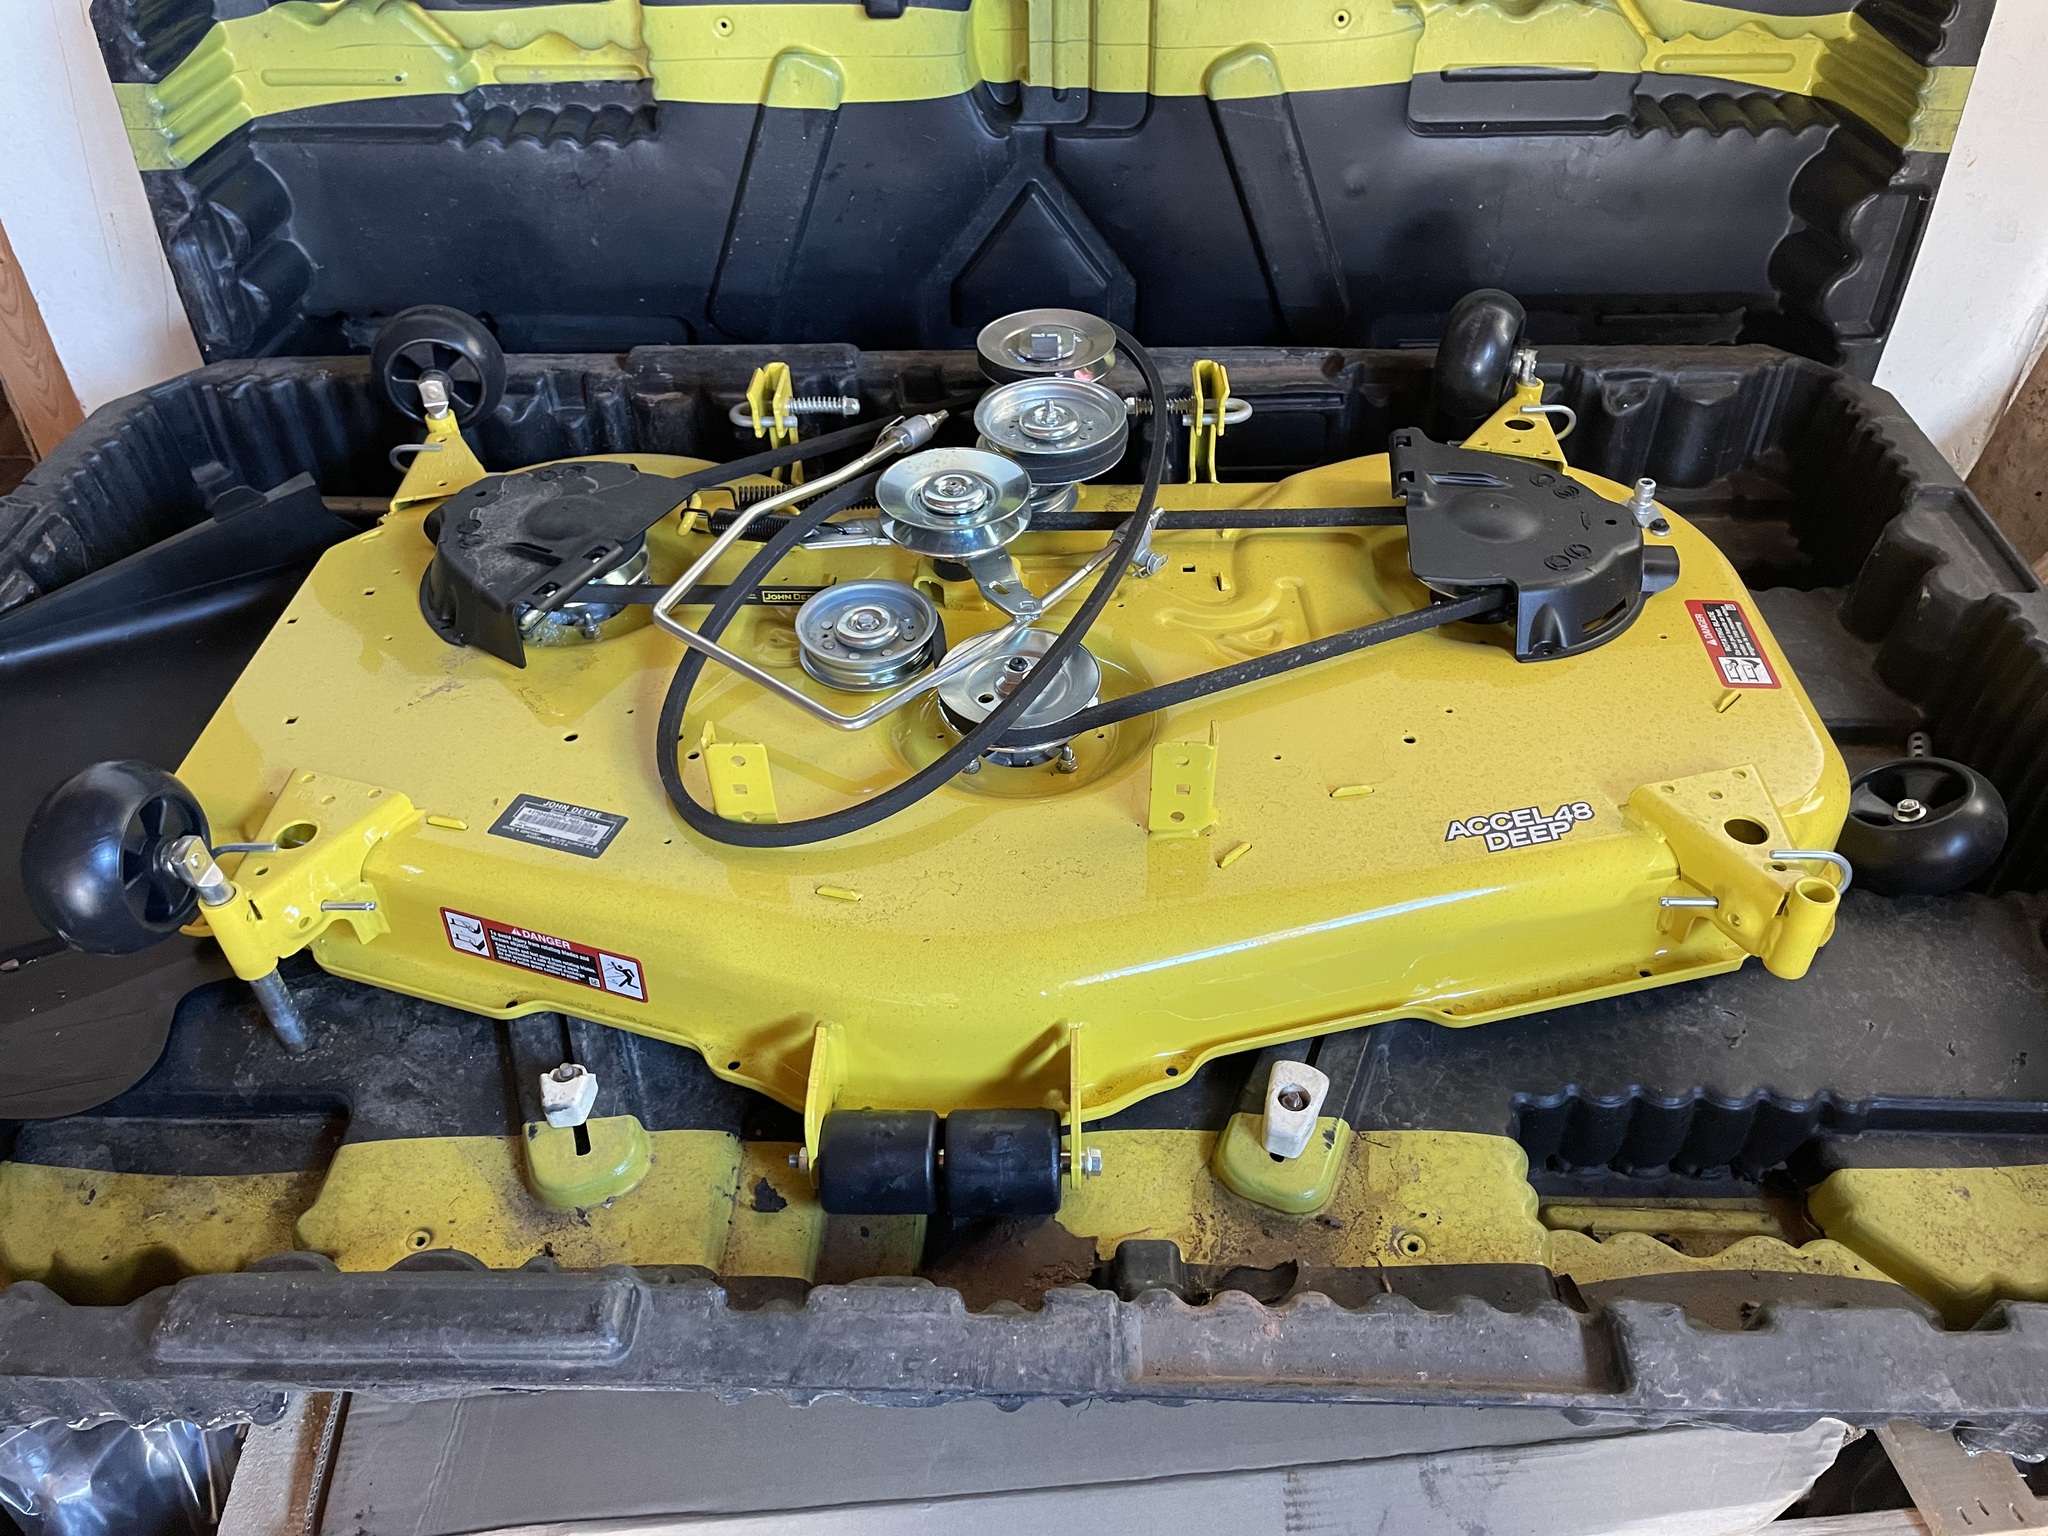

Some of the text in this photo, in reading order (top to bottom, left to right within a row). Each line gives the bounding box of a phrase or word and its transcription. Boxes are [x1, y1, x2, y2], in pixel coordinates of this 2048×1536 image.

[1695, 613, 1714, 640] DANGER
[543, 800, 571, 811] JOHN
[571, 804, 603, 819] DEERE
[1485, 821, 1573, 852] DEEP
[522, 929, 571, 949] DANGER
